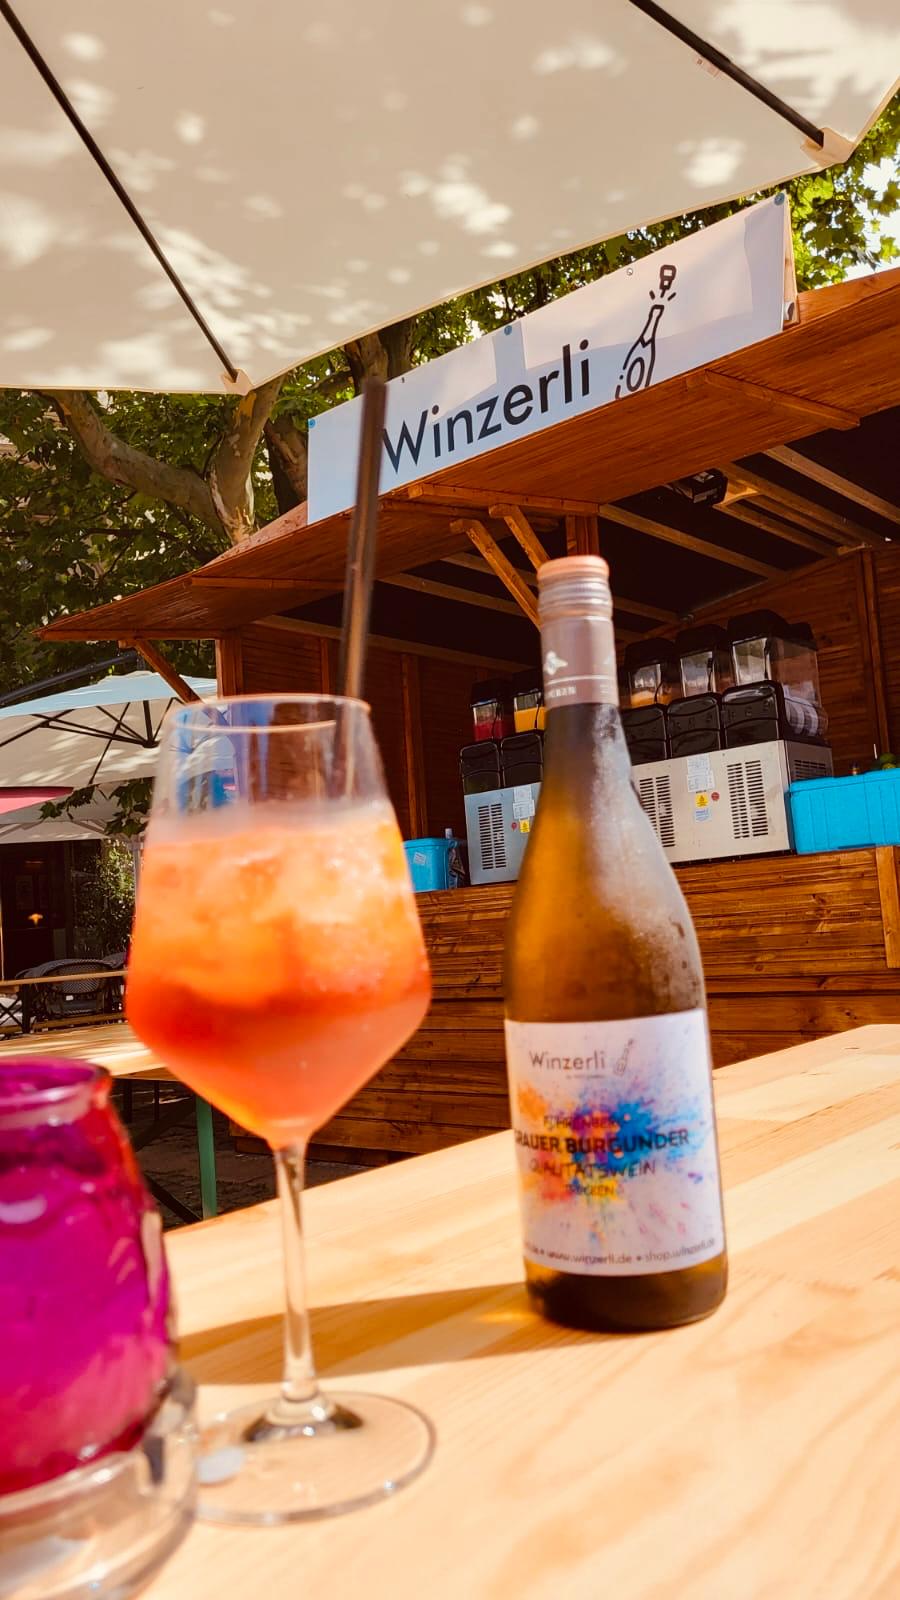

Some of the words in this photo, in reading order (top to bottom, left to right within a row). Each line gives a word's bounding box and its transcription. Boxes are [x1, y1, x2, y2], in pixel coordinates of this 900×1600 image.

[383, 339, 591, 474] Winzerli
[528, 1049, 606, 1070] Winzerli
[564, 1128, 690, 1153] BURGUNDER
